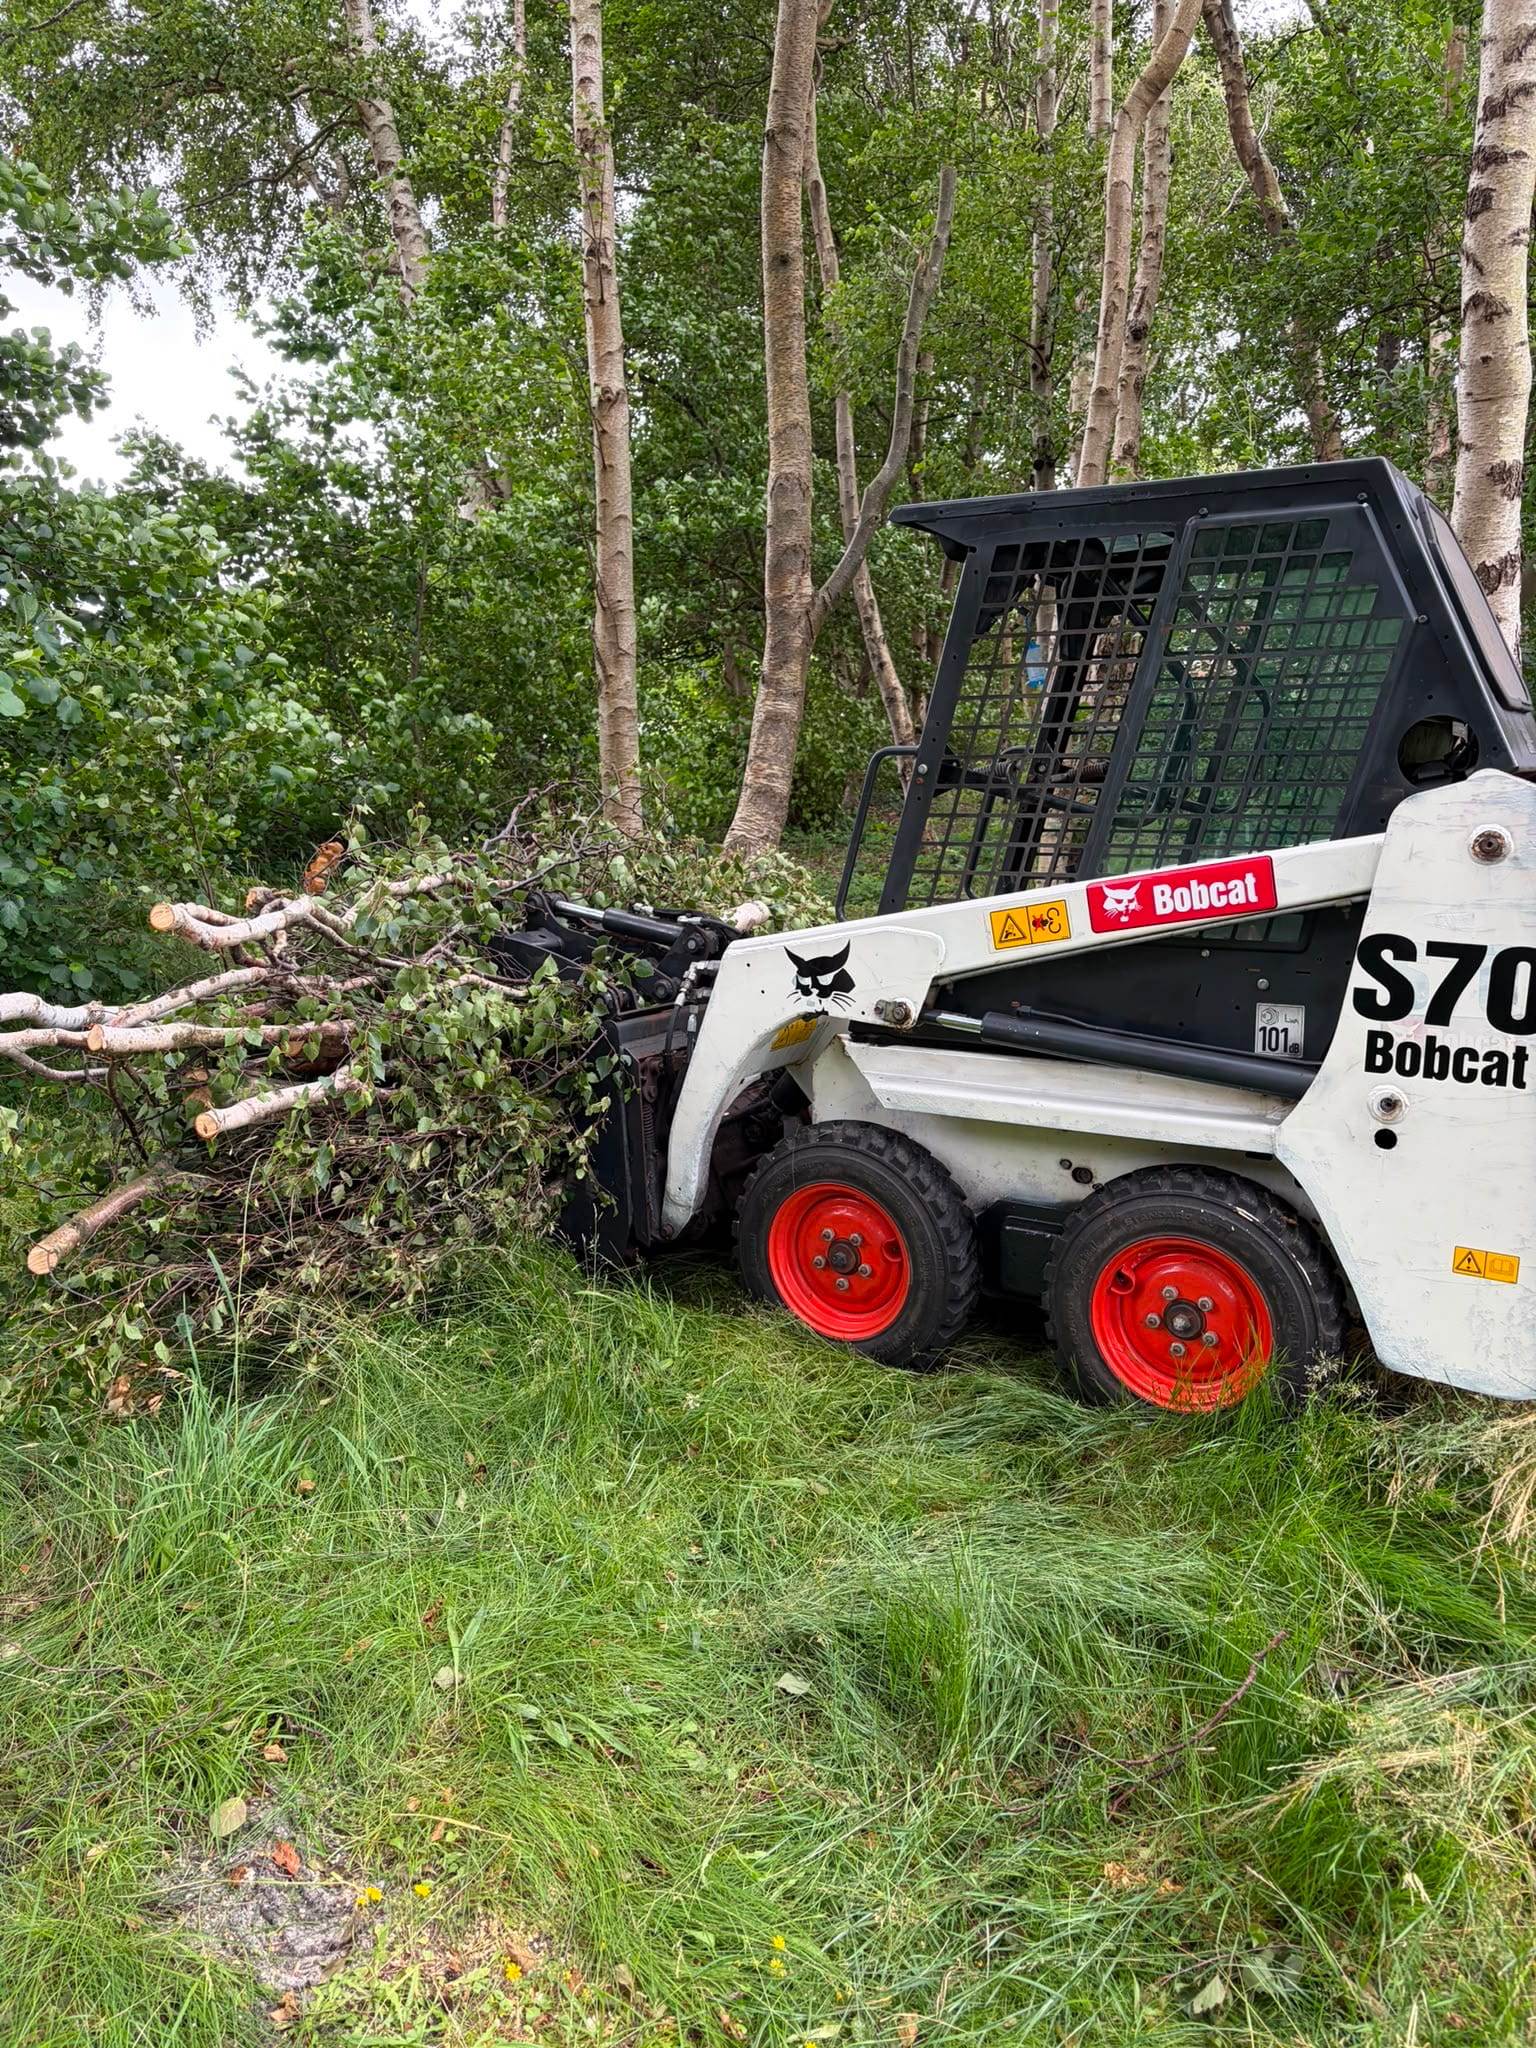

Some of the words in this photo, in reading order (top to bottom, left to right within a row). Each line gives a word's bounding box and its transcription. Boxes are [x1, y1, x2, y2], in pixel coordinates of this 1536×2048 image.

[1152, 872, 1259, 916] Bobcat
[1352, 932, 1536, 1036] S70
[1258, 1025, 1289, 1053] 101
[1364, 1029, 1530, 1089] Bobcat
